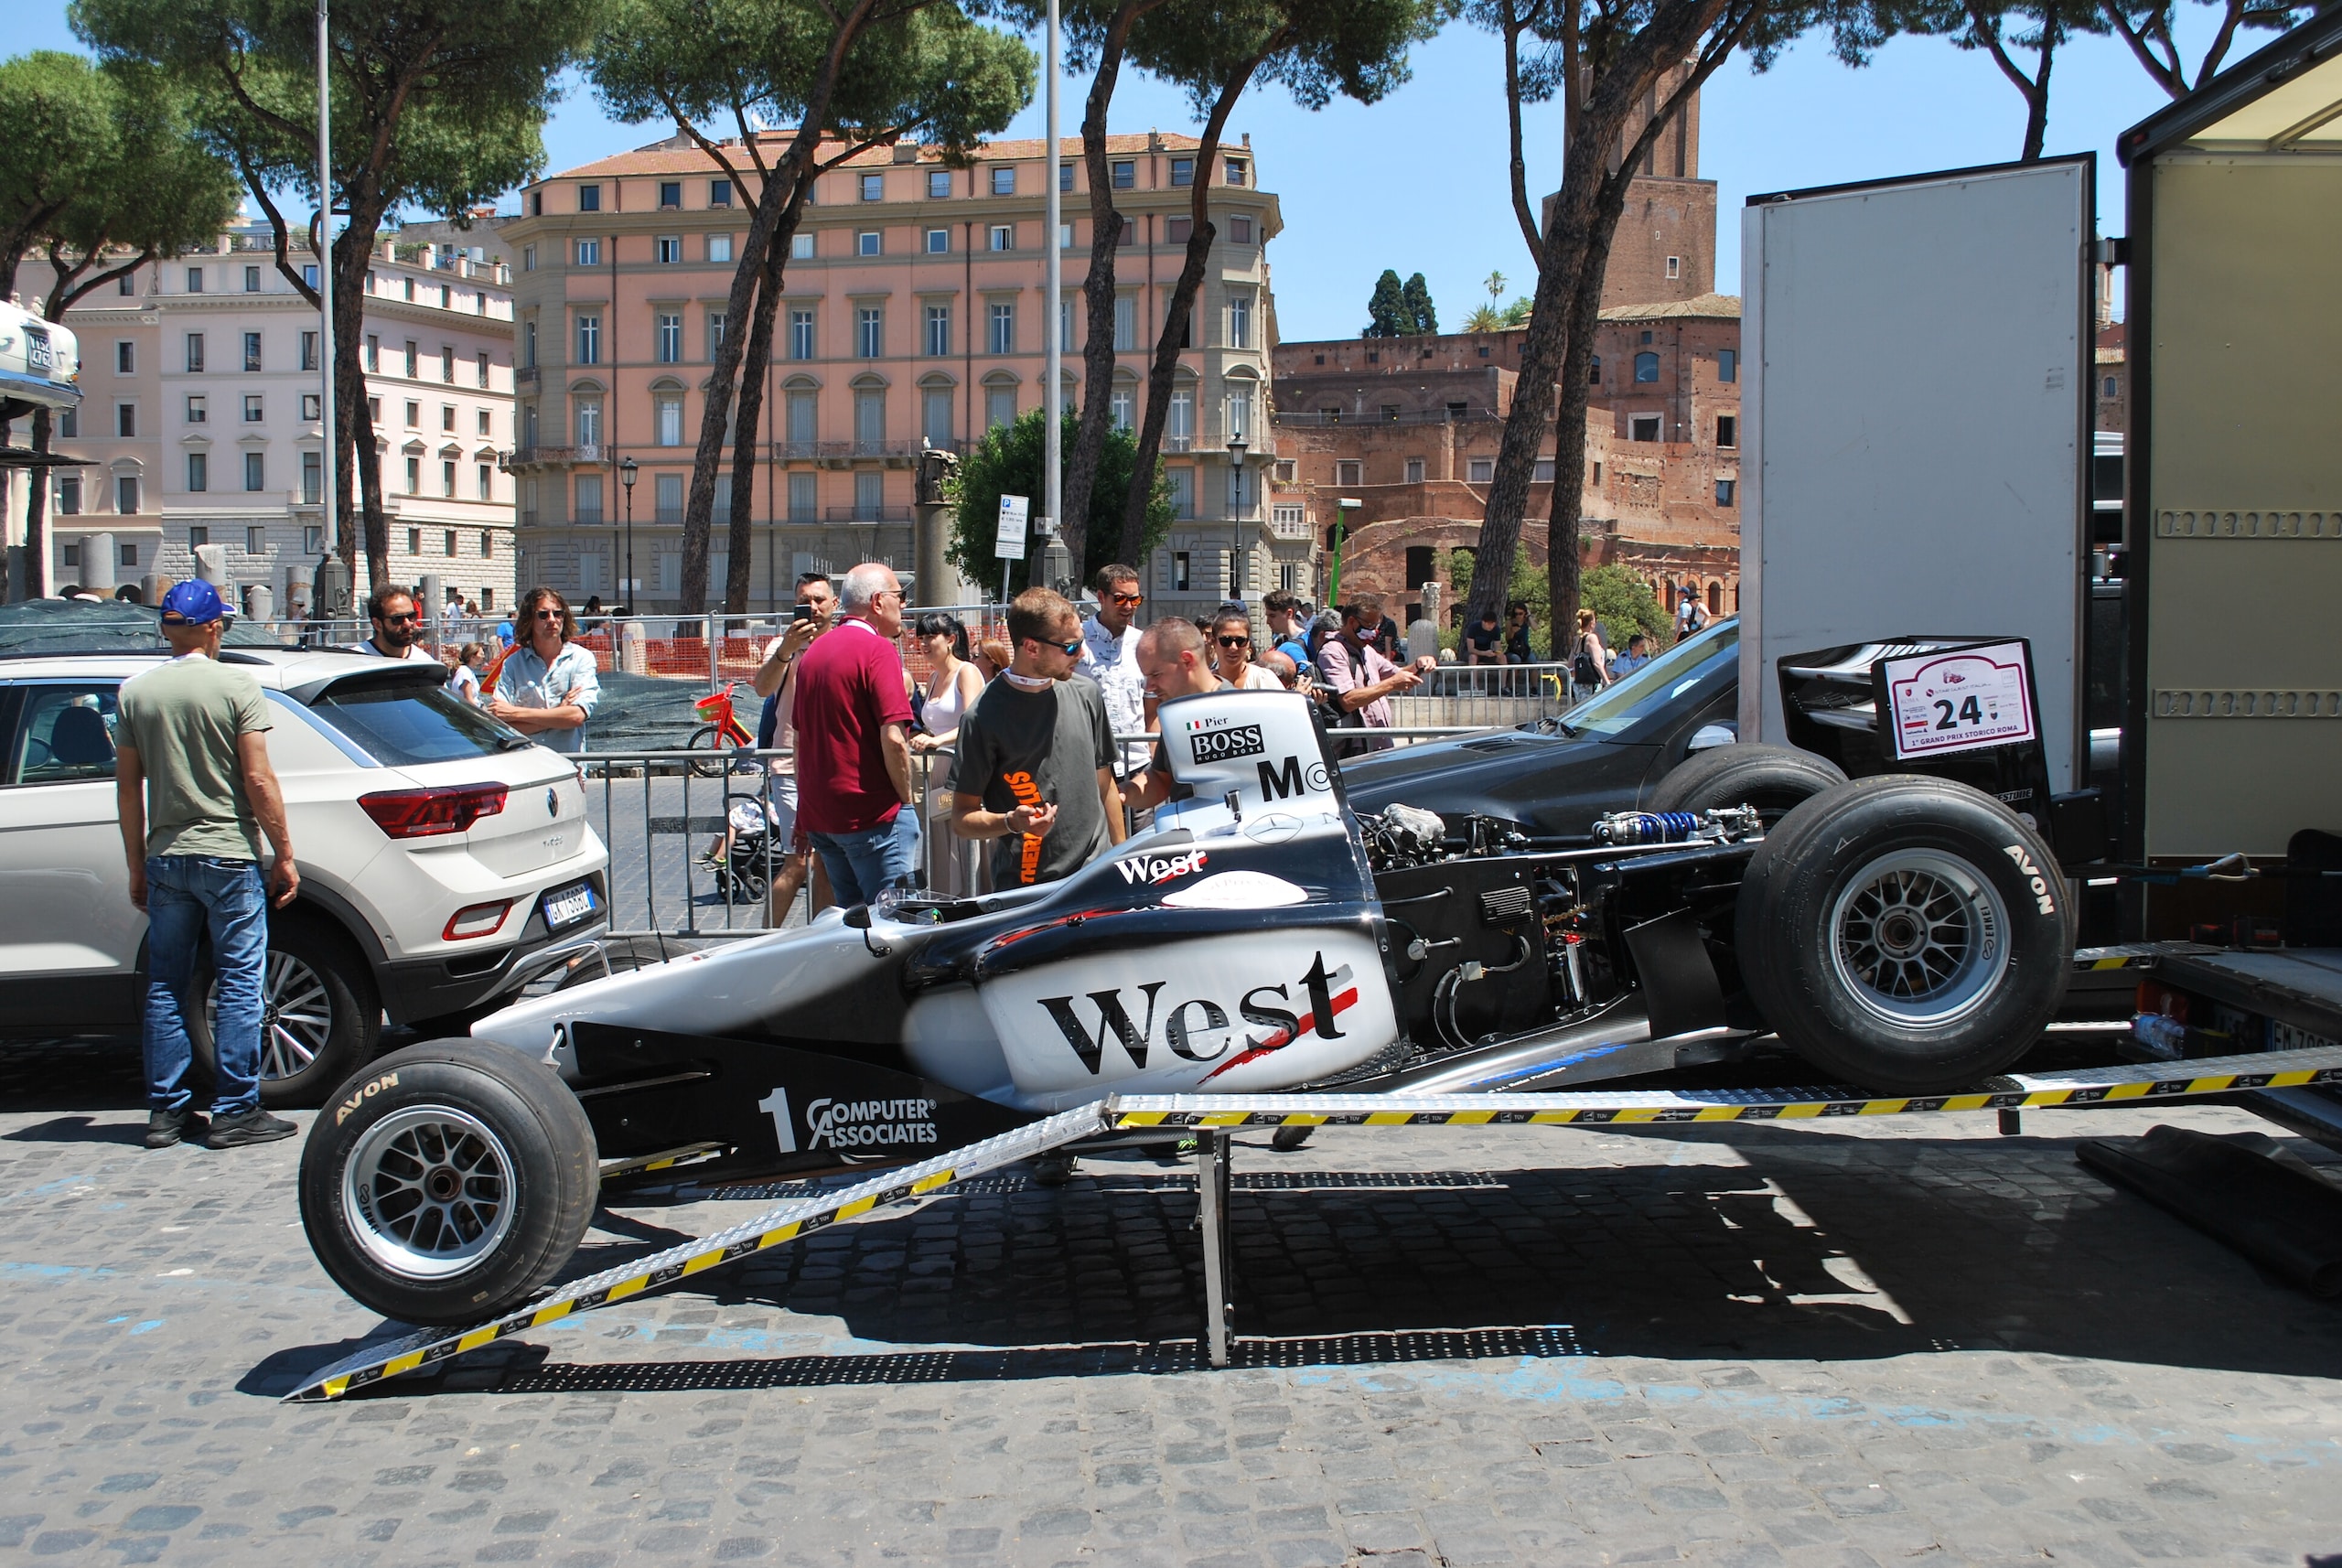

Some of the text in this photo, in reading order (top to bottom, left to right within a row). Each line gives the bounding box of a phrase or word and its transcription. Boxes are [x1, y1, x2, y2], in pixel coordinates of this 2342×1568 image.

[1205, 717, 1229, 727] Pier
[1933, 695, 1982, 730] 24
[1193, 727, 1261, 756] BOSS
[1920, 736, 1945, 745] GRAND
[1964, 727, 1995, 738] STORICO
[1997, 725, 2018, 733] ROMA
[1197, 746, 1262, 762] HUGO BOSS
[1114, 848, 1206, 885] West
[2003, 844, 2055, 916] AVON
[1981, 906, 1994, 938] ENKEI
[1037, 950, 1347, 1076] West
[337, 1072, 399, 1127] AVON
[758, 1086, 797, 1154] 1
[807, 1110, 937, 1151] ASSOCIATES
[361, 1205, 381, 1236] ENKEI
